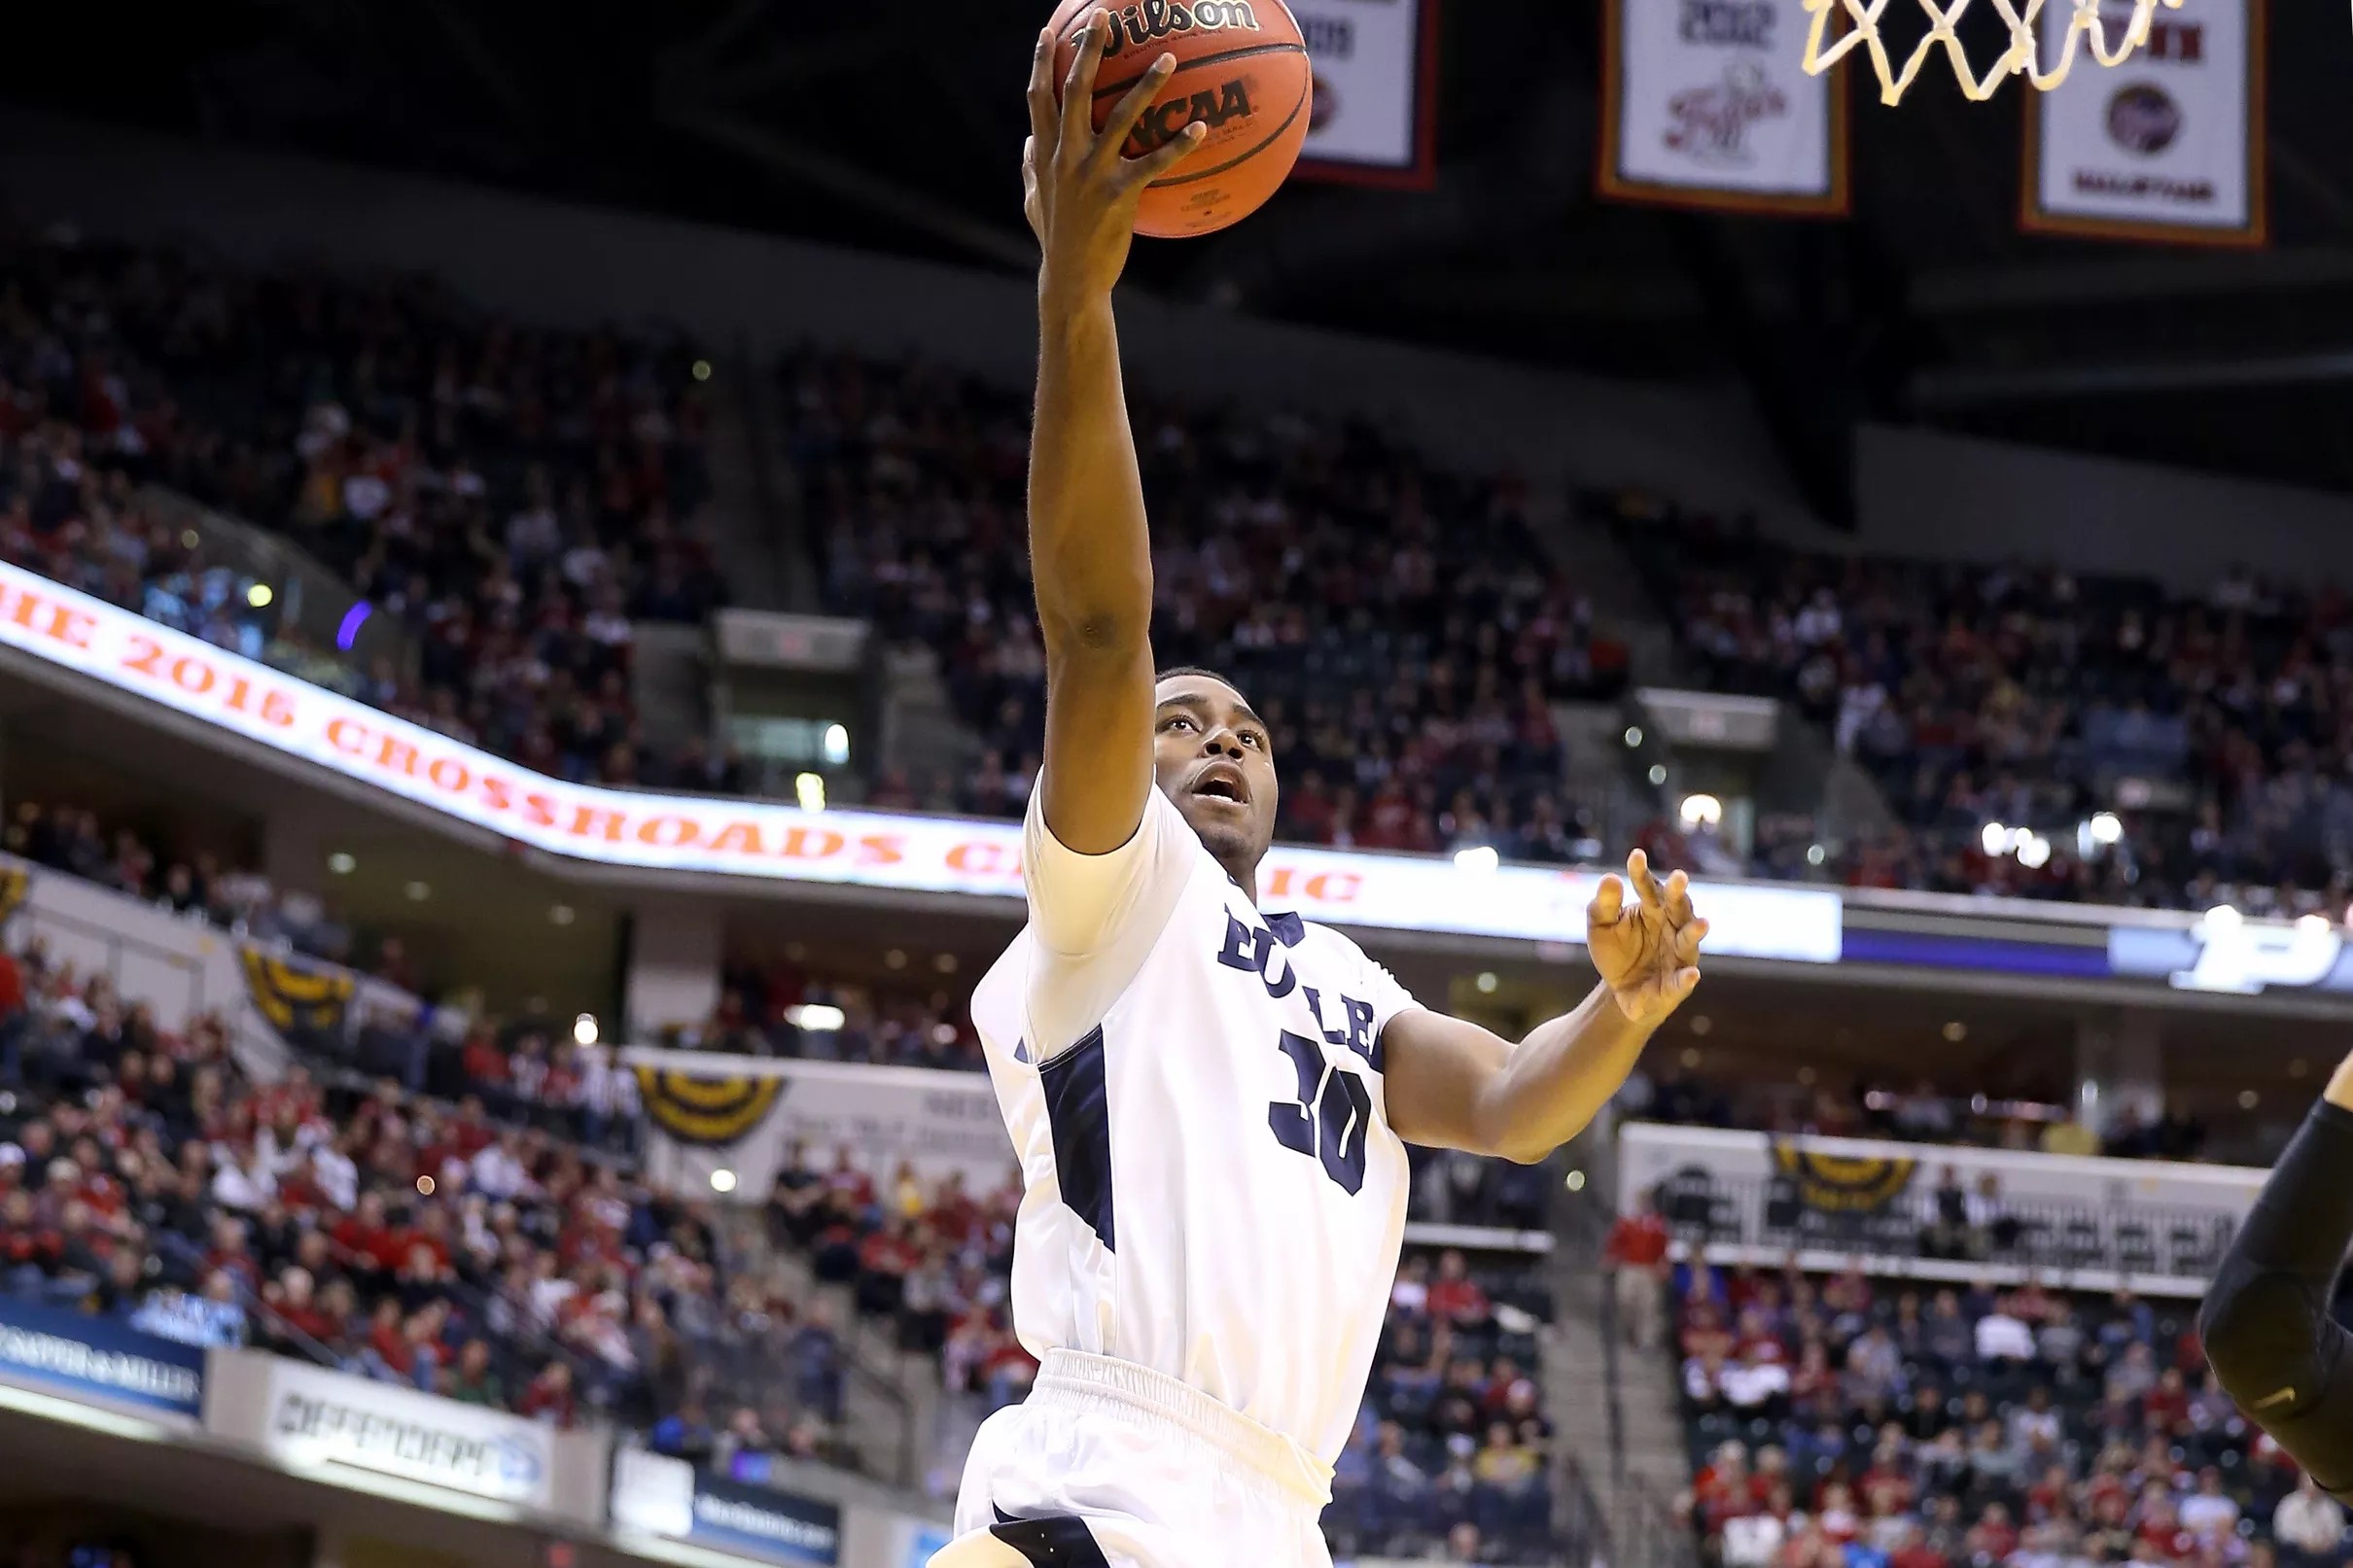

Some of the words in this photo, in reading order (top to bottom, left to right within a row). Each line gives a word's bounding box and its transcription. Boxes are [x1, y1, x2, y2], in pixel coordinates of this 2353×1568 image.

[0, 575, 96, 649] HE
[327, 716, 902, 865] CROSSROADS
[1268, 1028, 1372, 1198] 30
